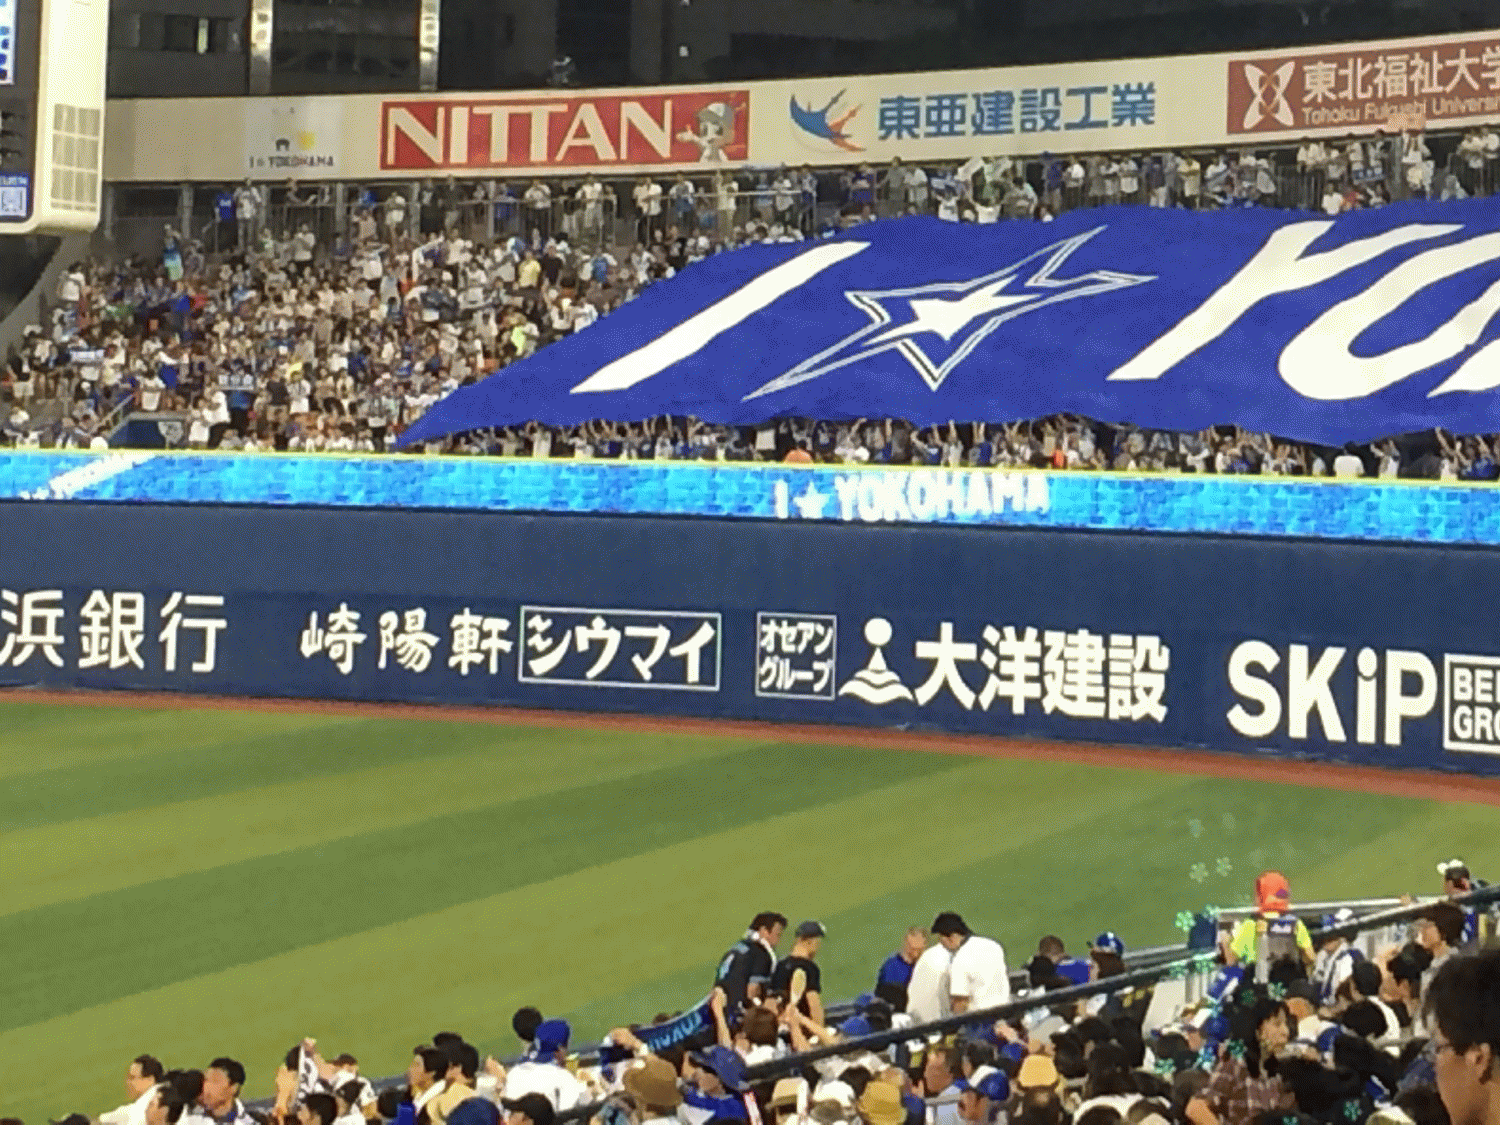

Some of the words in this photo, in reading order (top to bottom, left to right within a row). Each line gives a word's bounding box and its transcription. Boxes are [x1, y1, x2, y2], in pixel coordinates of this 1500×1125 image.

[386, 99, 674, 166] NITTAN
[877, 81, 1156, 141] 東亜建設工業
[570, 241, 872, 394] I
[774, 479, 789, 519] I
[835, 470, 1050, 522] YOKOHAMA
[0, 589, 228, 673] 浜銀行
[300, 602, 514, 676] 崎陽軒
[527, 614, 716, 683] シウマイ
[760, 618, 834, 655] オセアン
[760, 655, 834, 693] グループ
[914, 621, 1170, 723] 大洋建設
